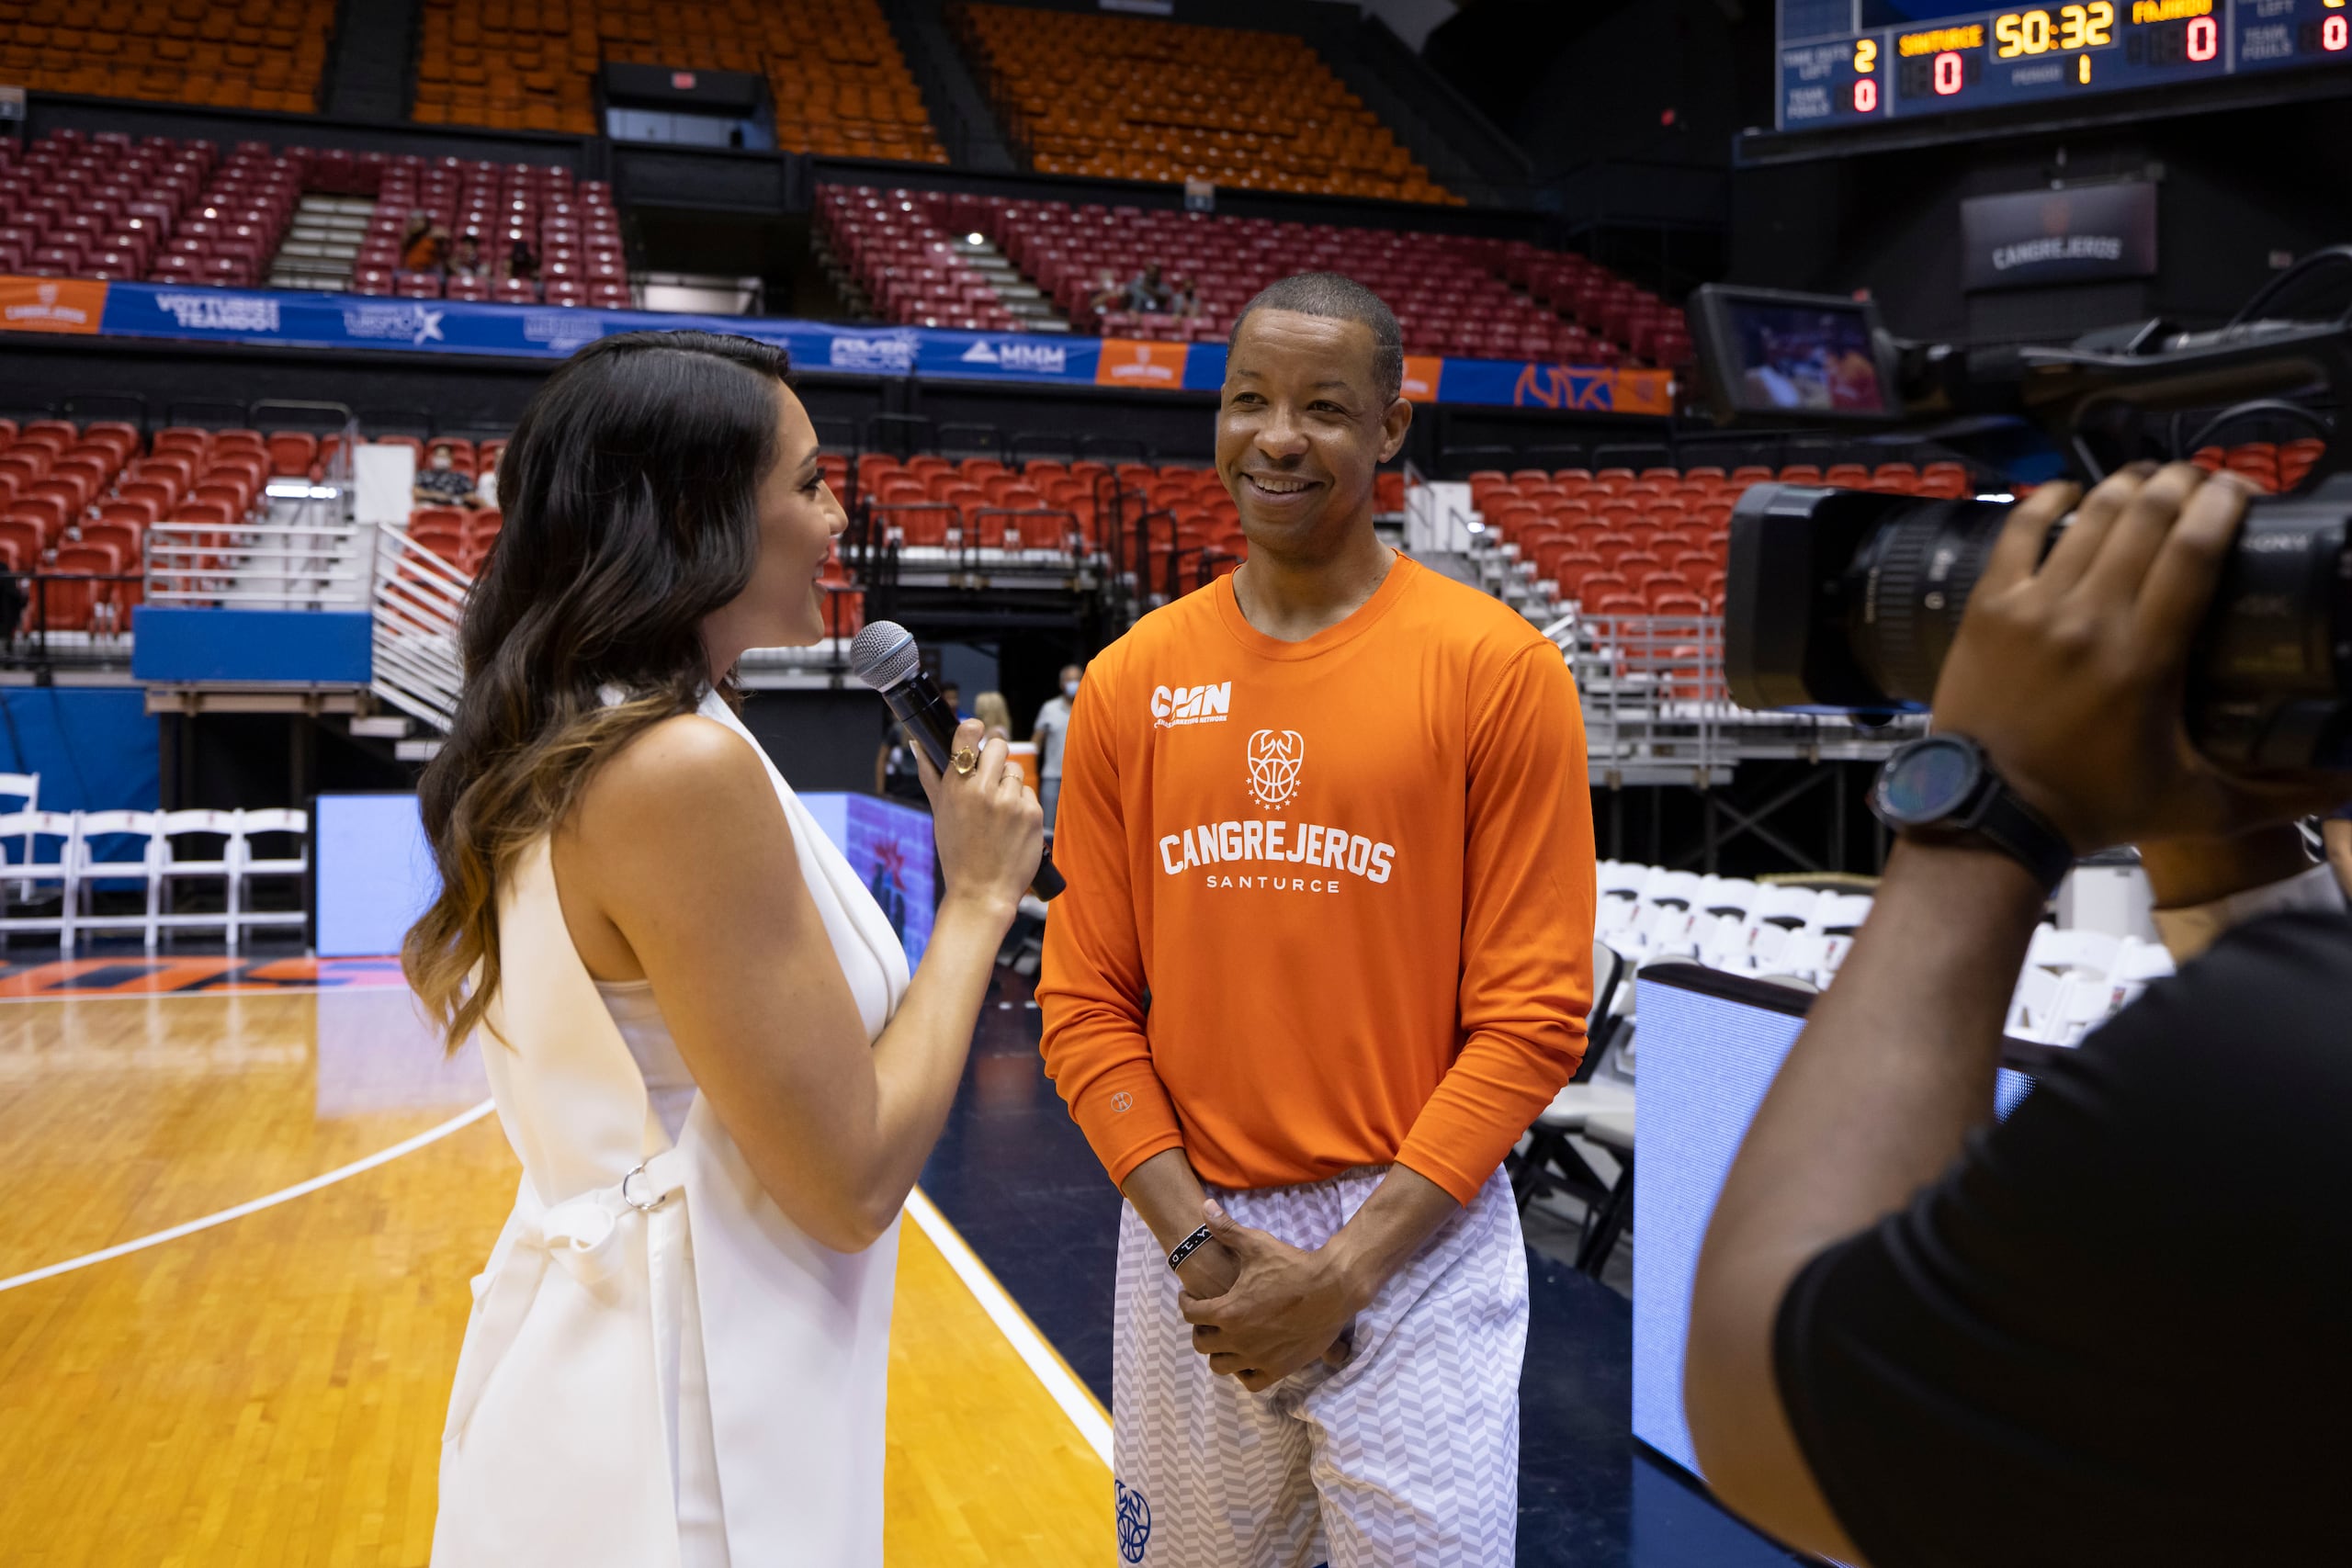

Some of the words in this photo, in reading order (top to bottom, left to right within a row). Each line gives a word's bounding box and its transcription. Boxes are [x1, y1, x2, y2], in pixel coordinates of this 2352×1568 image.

[1996, 1, 2113, 58] 50:32
[2187, 16, 2217, 62] 0
[2324, 15, 2348, 51] 0
[1853, 39, 1877, 73] 2
[1934, 51, 1962, 96] 0
[2078, 53, 2091, 85] 1
[1853, 78, 1877, 112] 0
[1992, 235, 2122, 270] CANGREJEROS
[1000, 344, 1066, 367] MMM
[1150, 681, 1232, 719] CMN
[1199, 715, 1227, 724] NETWORK
[1159, 820, 1396, 884] CANGREJEROS
[1206, 875, 1340, 894] SANTURCE
